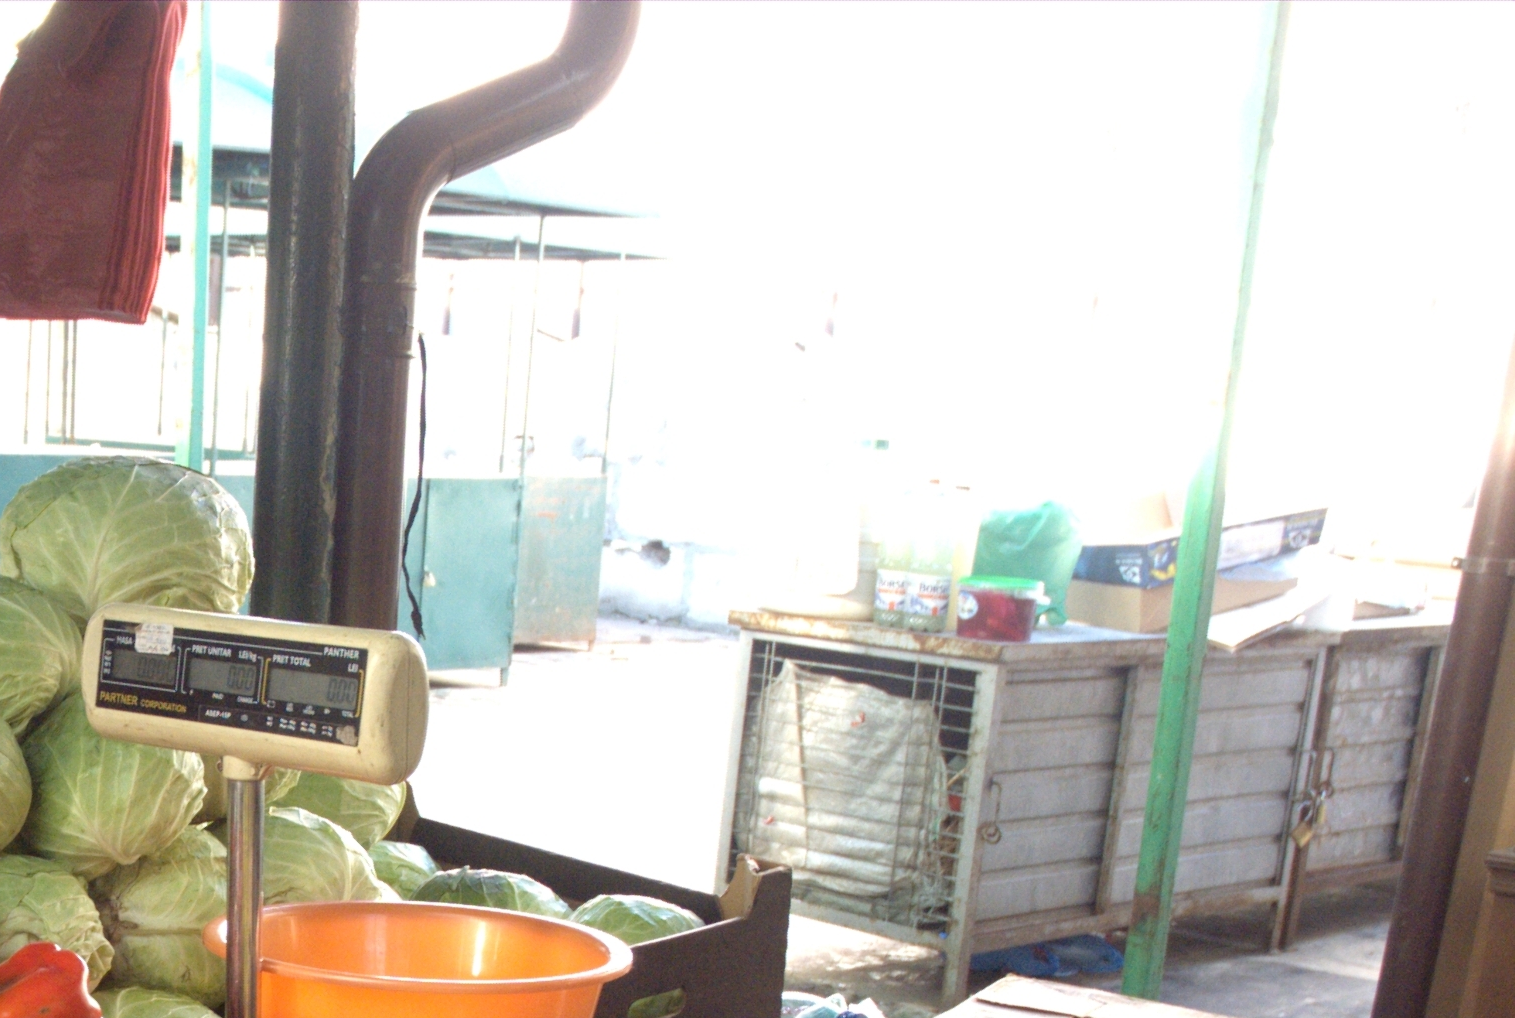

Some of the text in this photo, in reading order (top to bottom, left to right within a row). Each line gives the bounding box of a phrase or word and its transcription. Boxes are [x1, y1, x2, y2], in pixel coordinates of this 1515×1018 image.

[324, 646, 360, 660] PANTHER
[290, 656, 312, 667] TOTAL
[100, 690, 187, 713] PARTNER CORPORATION
